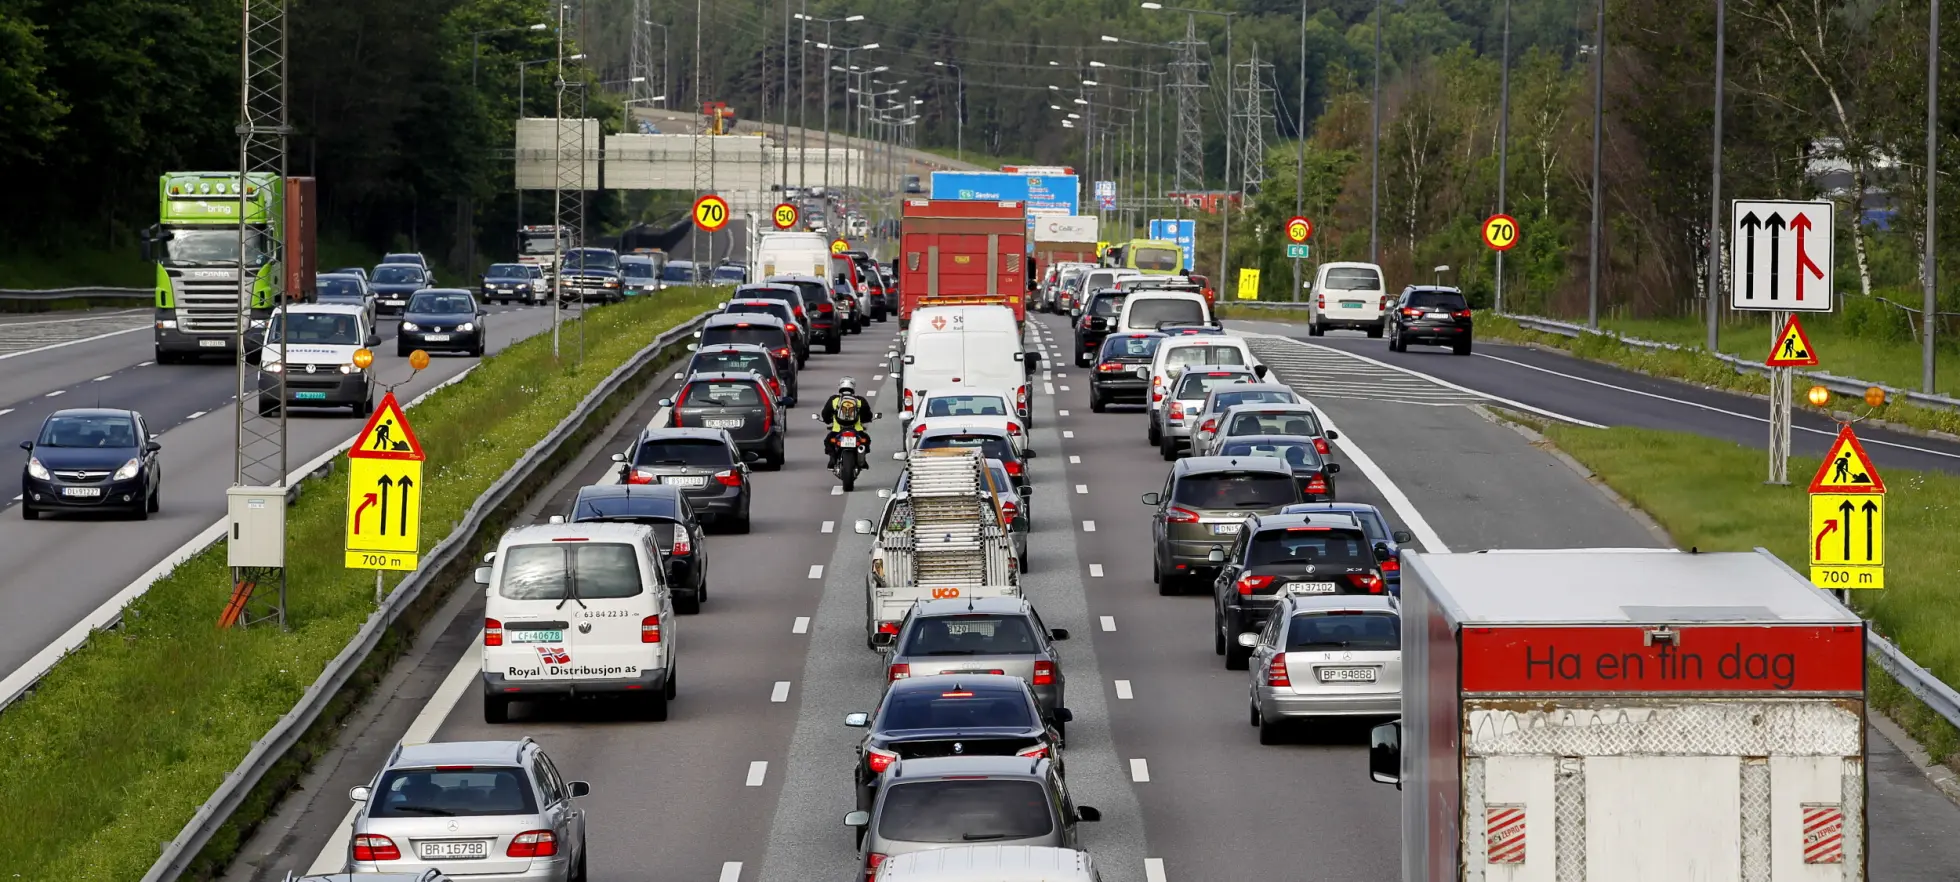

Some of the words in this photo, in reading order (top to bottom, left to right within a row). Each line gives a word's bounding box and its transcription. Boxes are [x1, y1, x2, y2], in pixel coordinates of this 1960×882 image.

[207, 203, 231, 214] bring
[702, 204, 723, 222] 70
[778, 209, 794, 222] 50
[1292, 227, 1305, 238] 50
[1491, 224, 1513, 241] 70
[1291, 246, 1304, 255] E6
[362, 554, 387, 566] 700
[391, 558, 401, 566] m
[1822, 570, 1850, 583] 700
[1859, 573, 1872, 583] m
[1289, 583, 1300, 592] CF
[1305, 583, 1333, 592] 37102
[518, 631, 529, 640] CF
[532, 631, 560, 640] 40678
[509, 666, 541, 678] Royal
[550, 664, 622, 677] Distribusjon
[624, 665, 637, 674] as
[1525, 644, 1581, 680] Ha
[1596, 652, 1644, 680] en
[1657, 643, 1703, 680] fin
[1717, 642, 1796, 690] dag
[1323, 671, 1336, 679] BP
[1341, 670, 1372, 679] 94868
[1501, 825, 1520, 839] ZEPRO
[1817, 825, 1836, 839] ZEPRO
[425, 843, 440, 855] BR
[446, 842, 483, 855] 16798
